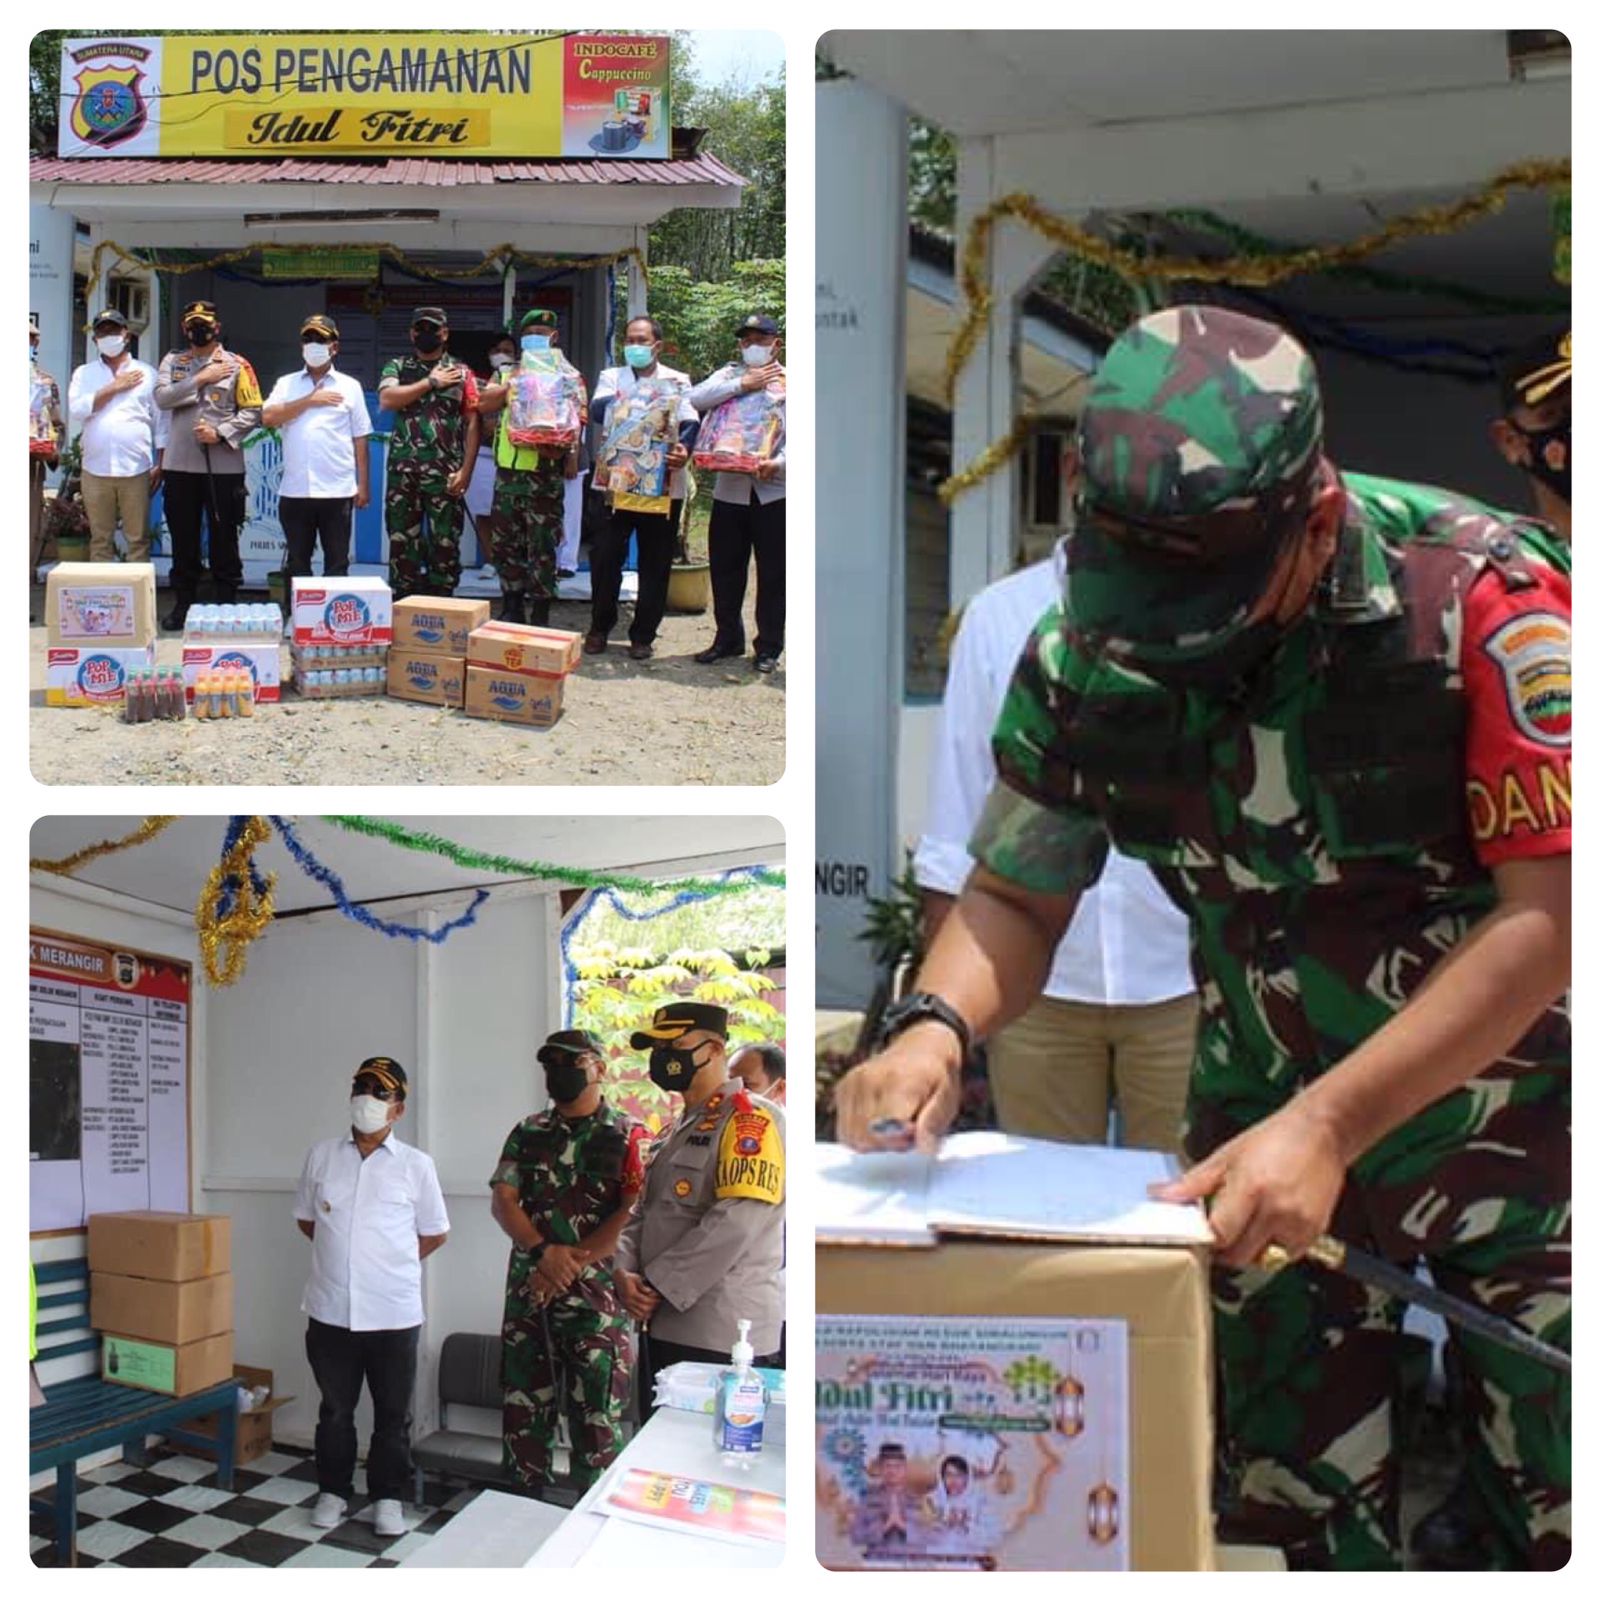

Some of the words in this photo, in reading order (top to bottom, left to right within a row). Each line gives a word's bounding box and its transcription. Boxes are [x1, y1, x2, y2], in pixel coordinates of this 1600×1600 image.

[191, 49, 262, 95] POS
[274, 47, 531, 93] PENGAMANAN
[579, 58, 651, 82] Cappuccino
[247, 109, 343, 145] Idul
[360, 109, 469, 143] Fitri
[411, 613, 445, 629] AQUA
[86, 660, 110, 675] POP
[406, 660, 438, 677] AQUA
[488, 680, 526, 697] AQUA
[40, 946, 104, 973] MERANGIR
